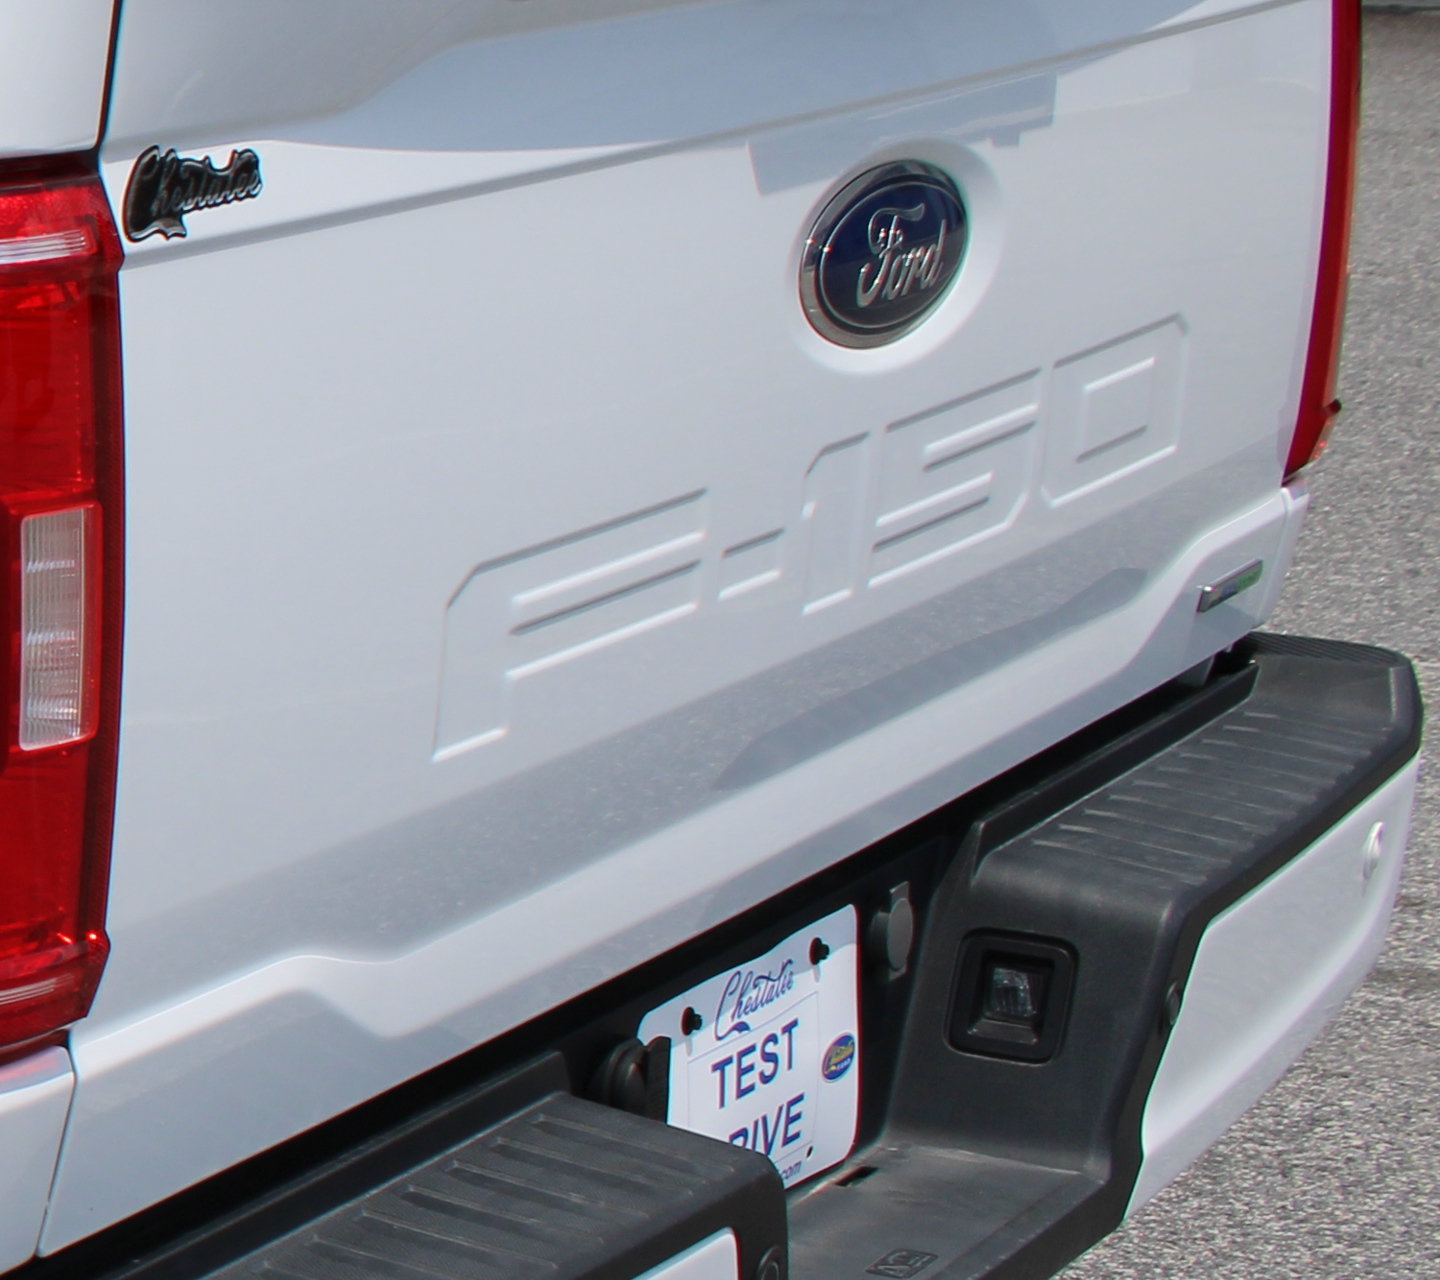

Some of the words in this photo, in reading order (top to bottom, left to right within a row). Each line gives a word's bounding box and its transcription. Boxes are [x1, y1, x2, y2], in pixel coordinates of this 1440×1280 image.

[856, 202, 947, 308] Ford
[431, 313, 1189, 764] F-150
[710, 1017, 800, 1110] TEST
